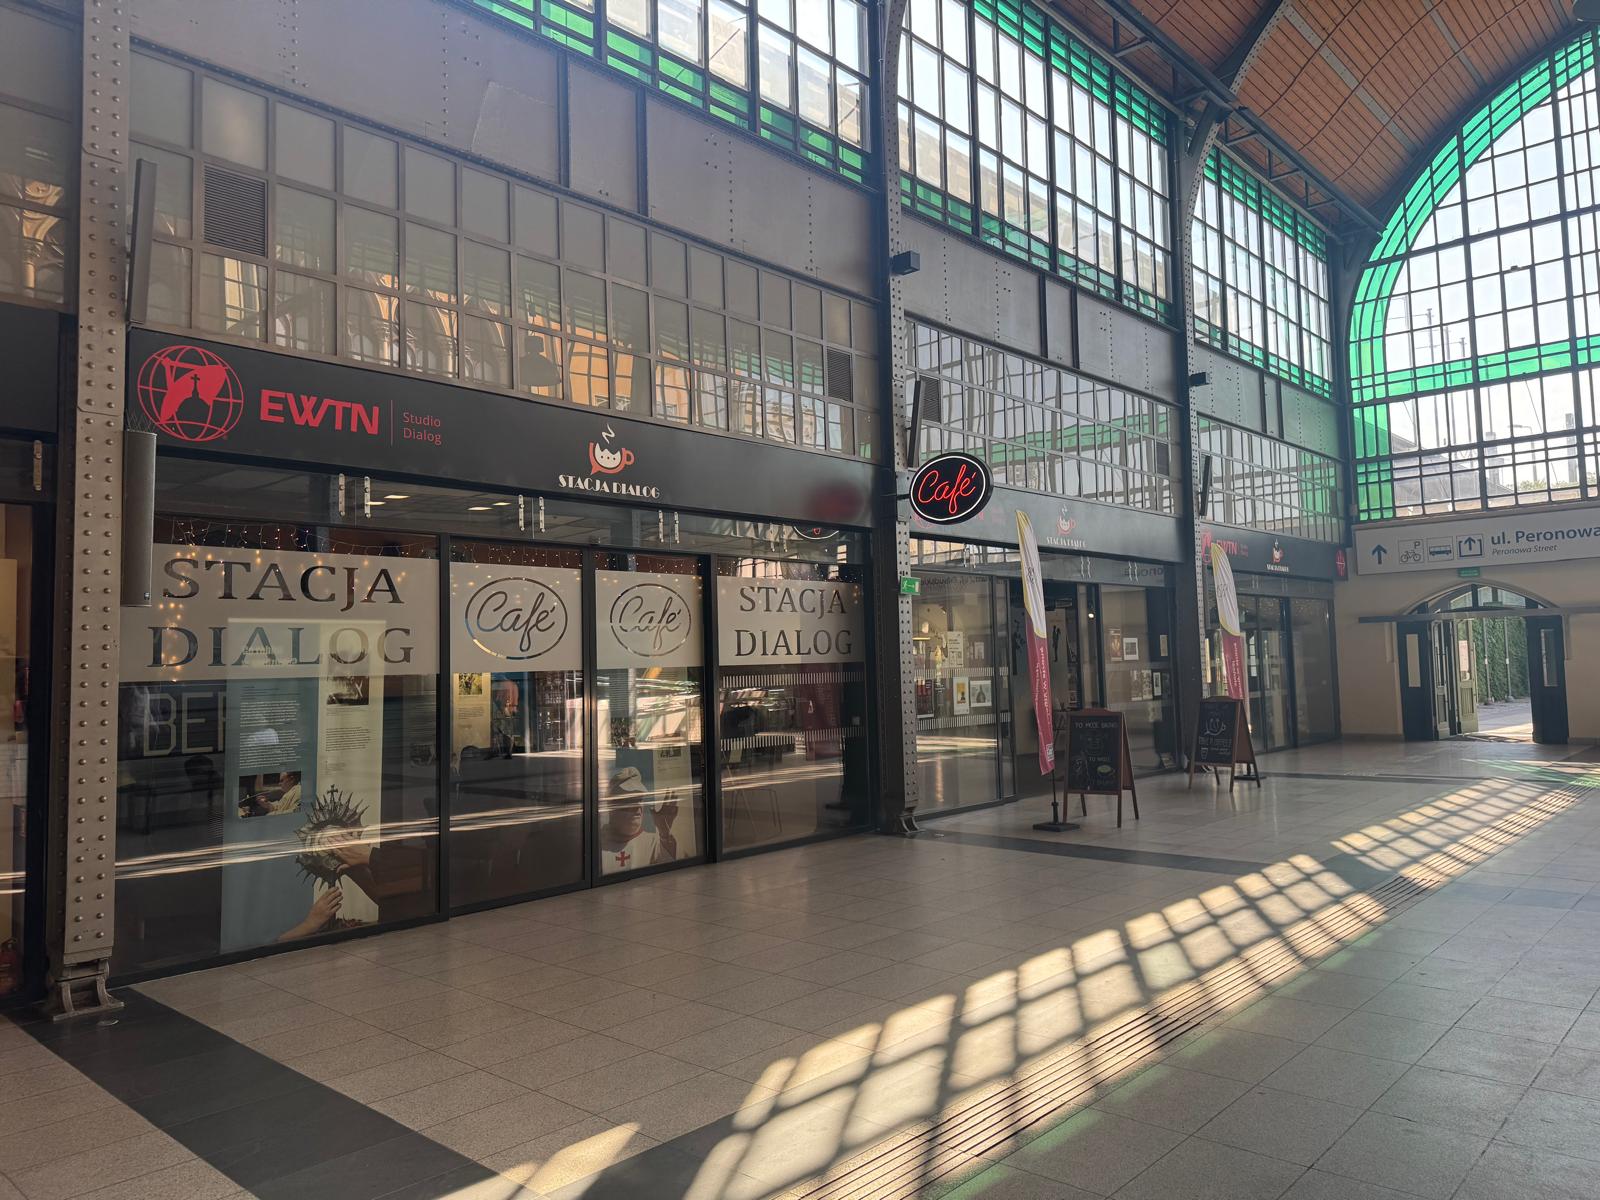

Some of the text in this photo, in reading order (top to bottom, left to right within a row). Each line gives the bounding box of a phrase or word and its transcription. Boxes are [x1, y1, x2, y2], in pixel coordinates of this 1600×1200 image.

[260, 389, 380, 436] EWTN
[403, 411, 441, 427] Studio
[403, 427, 442, 446] Dialog
[558, 474, 660, 499] STACJA DIALOG
[918, 463, 977, 514] Café
[1414, 541, 1421, 549] P
[1491, 526, 1600, 545] ul. Peronowa
[1492, 544, 1558, 555] Peronowa Street
[162, 557, 405, 612] STACJA
[739, 586, 847, 619] STACJA
[476, 591, 556, 652] Café
[619, 595, 682, 651] Café
[147, 626, 414, 667] DIALOG
[734, 629, 853, 657] DIALOG
